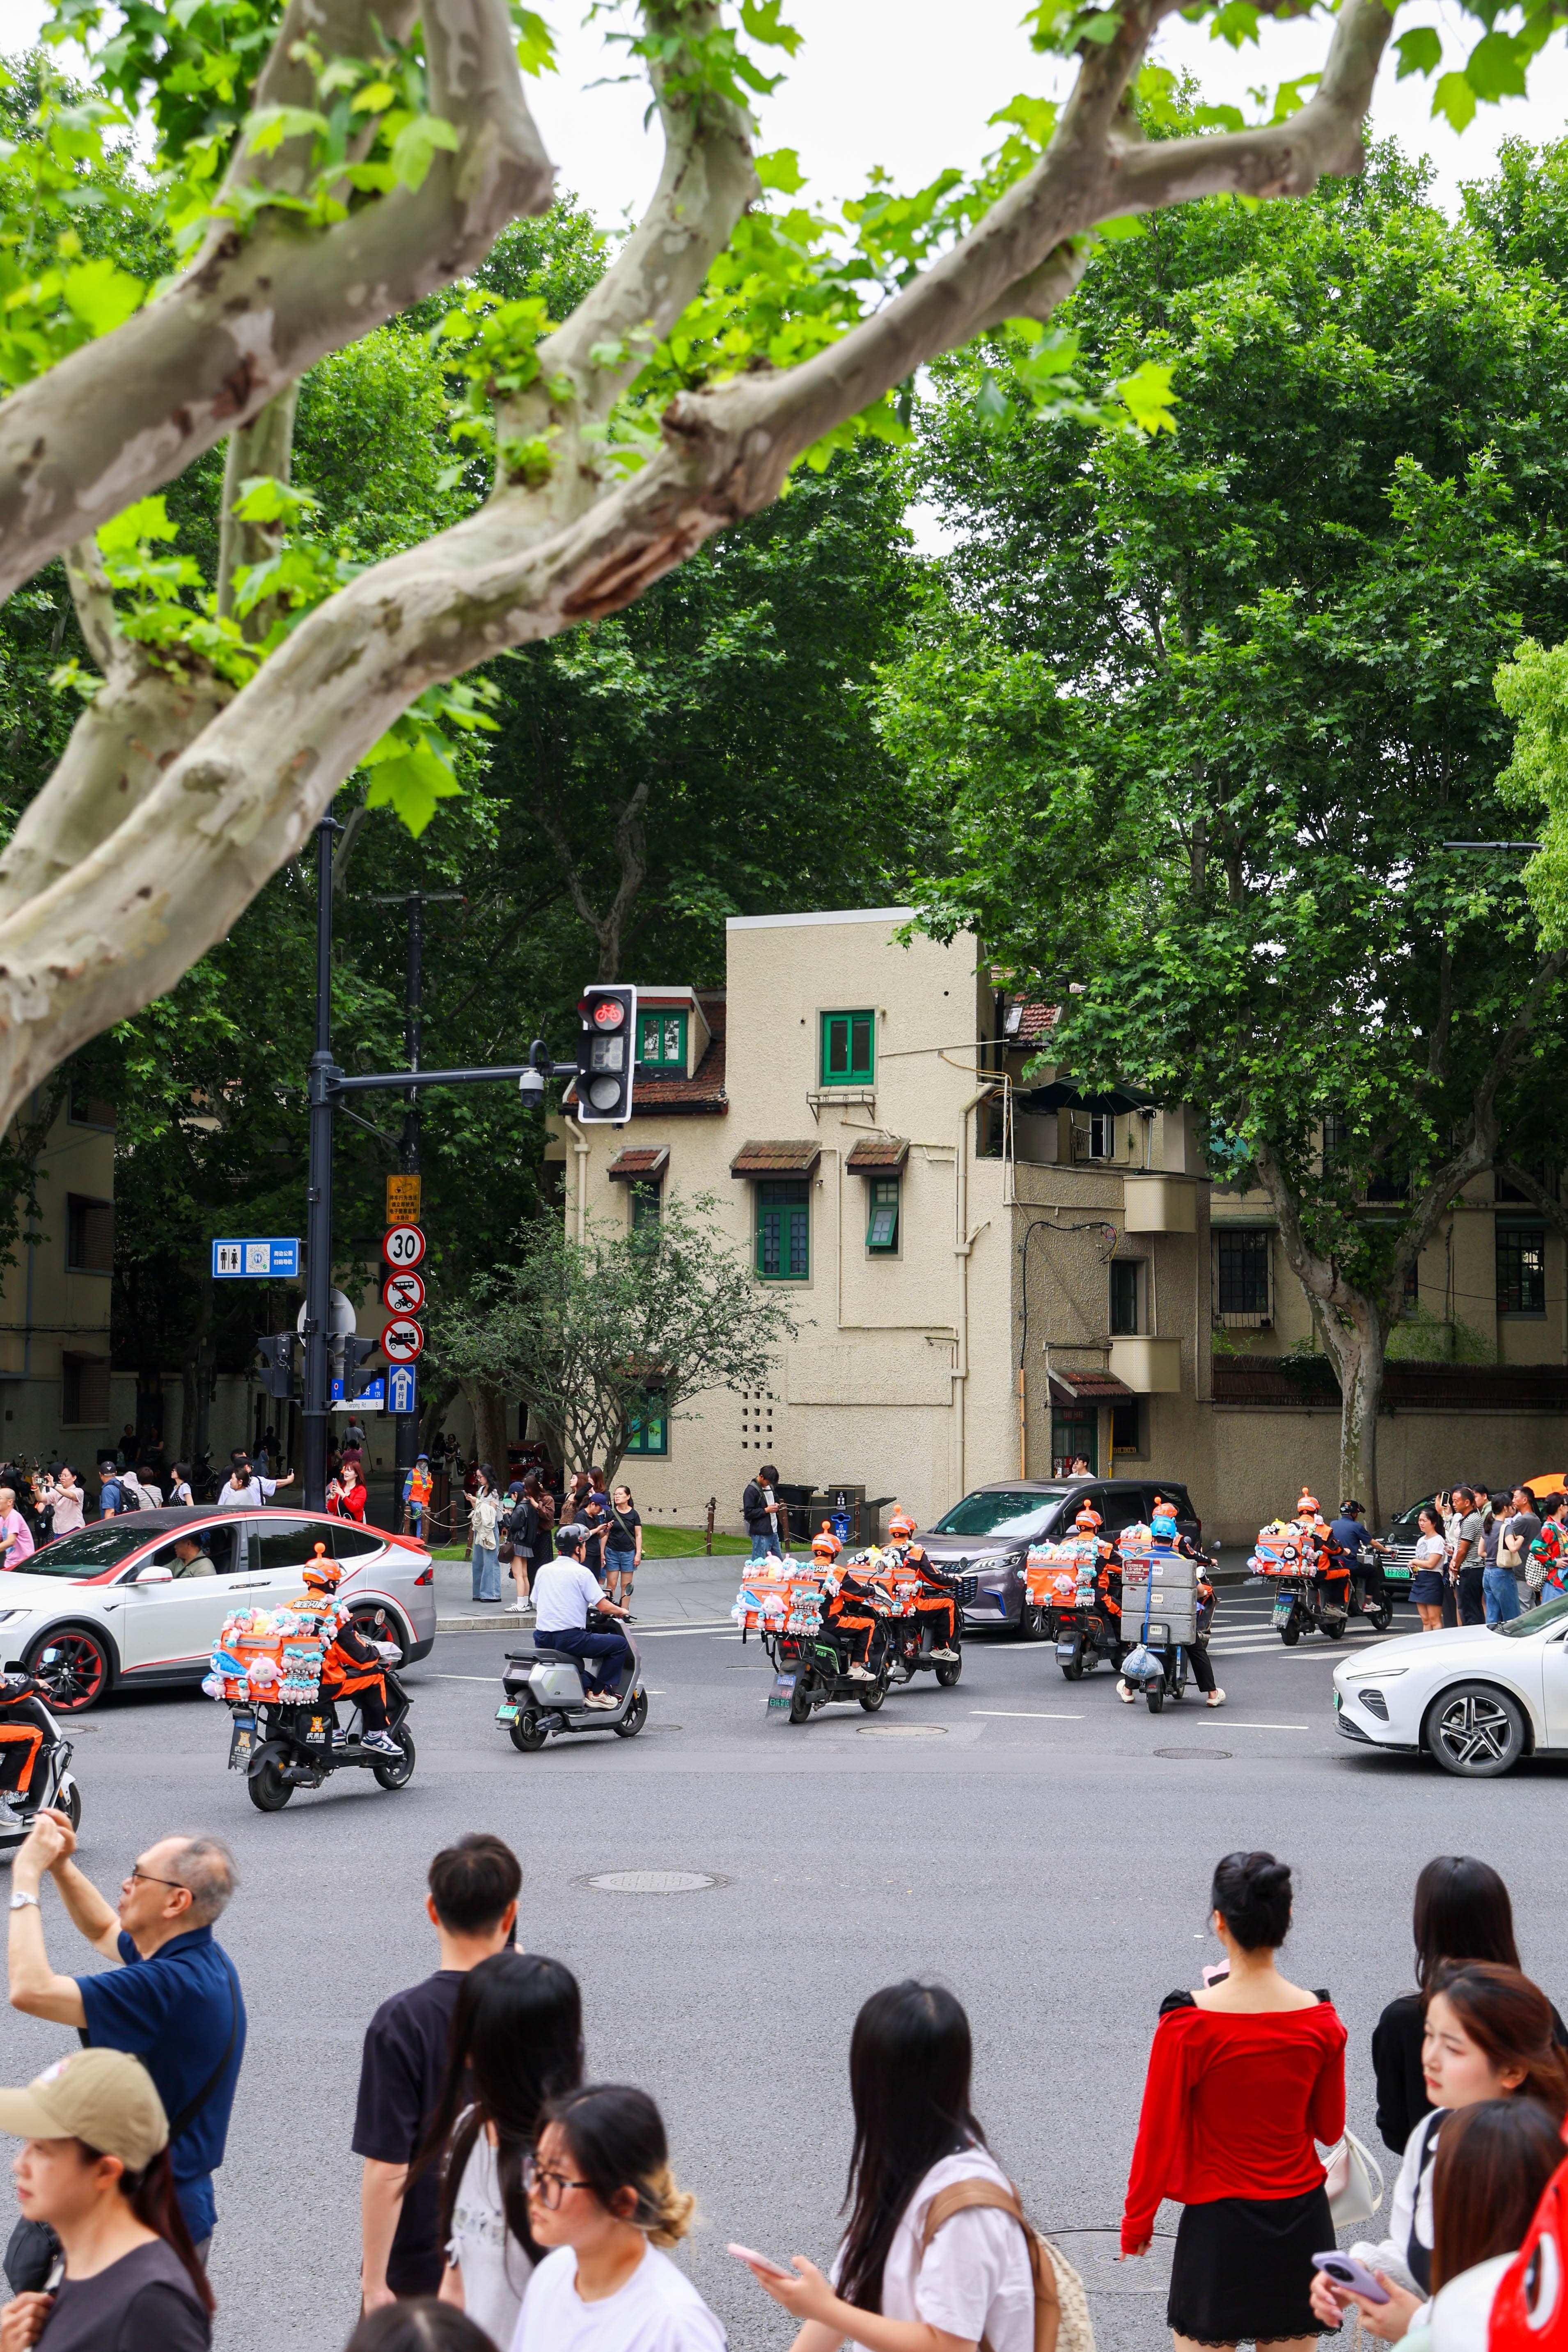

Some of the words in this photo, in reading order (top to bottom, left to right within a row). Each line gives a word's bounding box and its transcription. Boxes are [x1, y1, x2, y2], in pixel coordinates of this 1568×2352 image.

[393, 1234, 415, 1259] 30
[292, 1600, 328, 1610] 淘宝闪购
